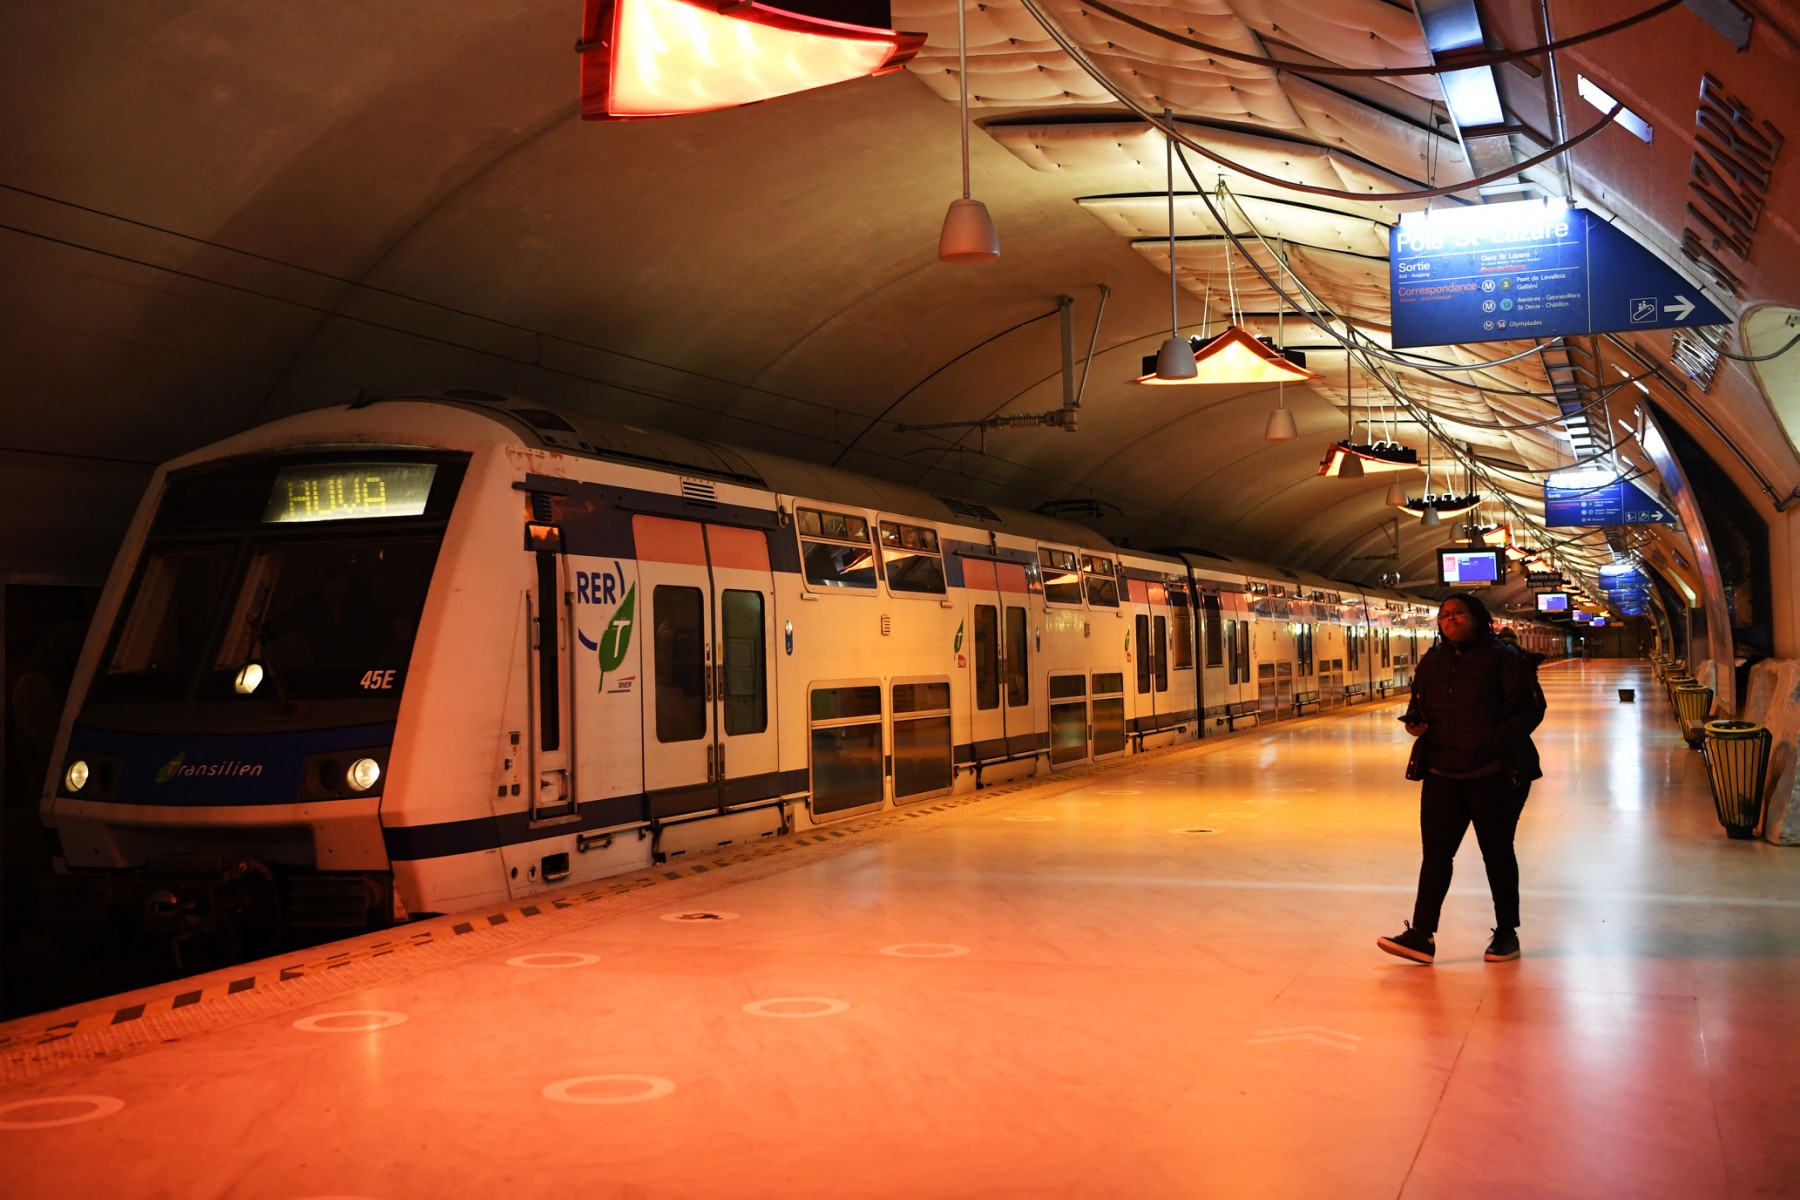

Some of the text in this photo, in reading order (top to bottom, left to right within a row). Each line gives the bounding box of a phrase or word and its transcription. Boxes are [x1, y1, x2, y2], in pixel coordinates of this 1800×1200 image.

[1491, 221, 1569, 244] Lazare
[1499, 253, 1507, 261] St
[1508, 252, 1531, 260] Lazare
[1398, 261, 1431, 273] Sortie
[1540, 272, 1567, 281] Levallois
[1398, 282, 1478, 297] Correspondance
[1546, 292, 1581, 301] Gennevilliers
[1509, 320, 1543, 328] Olympiades
[288, 476, 387, 516] HUVA
[576, 571, 617, 606] RER
[360, 669, 397, 690] 45E
[167, 760, 264, 777] Transilien
